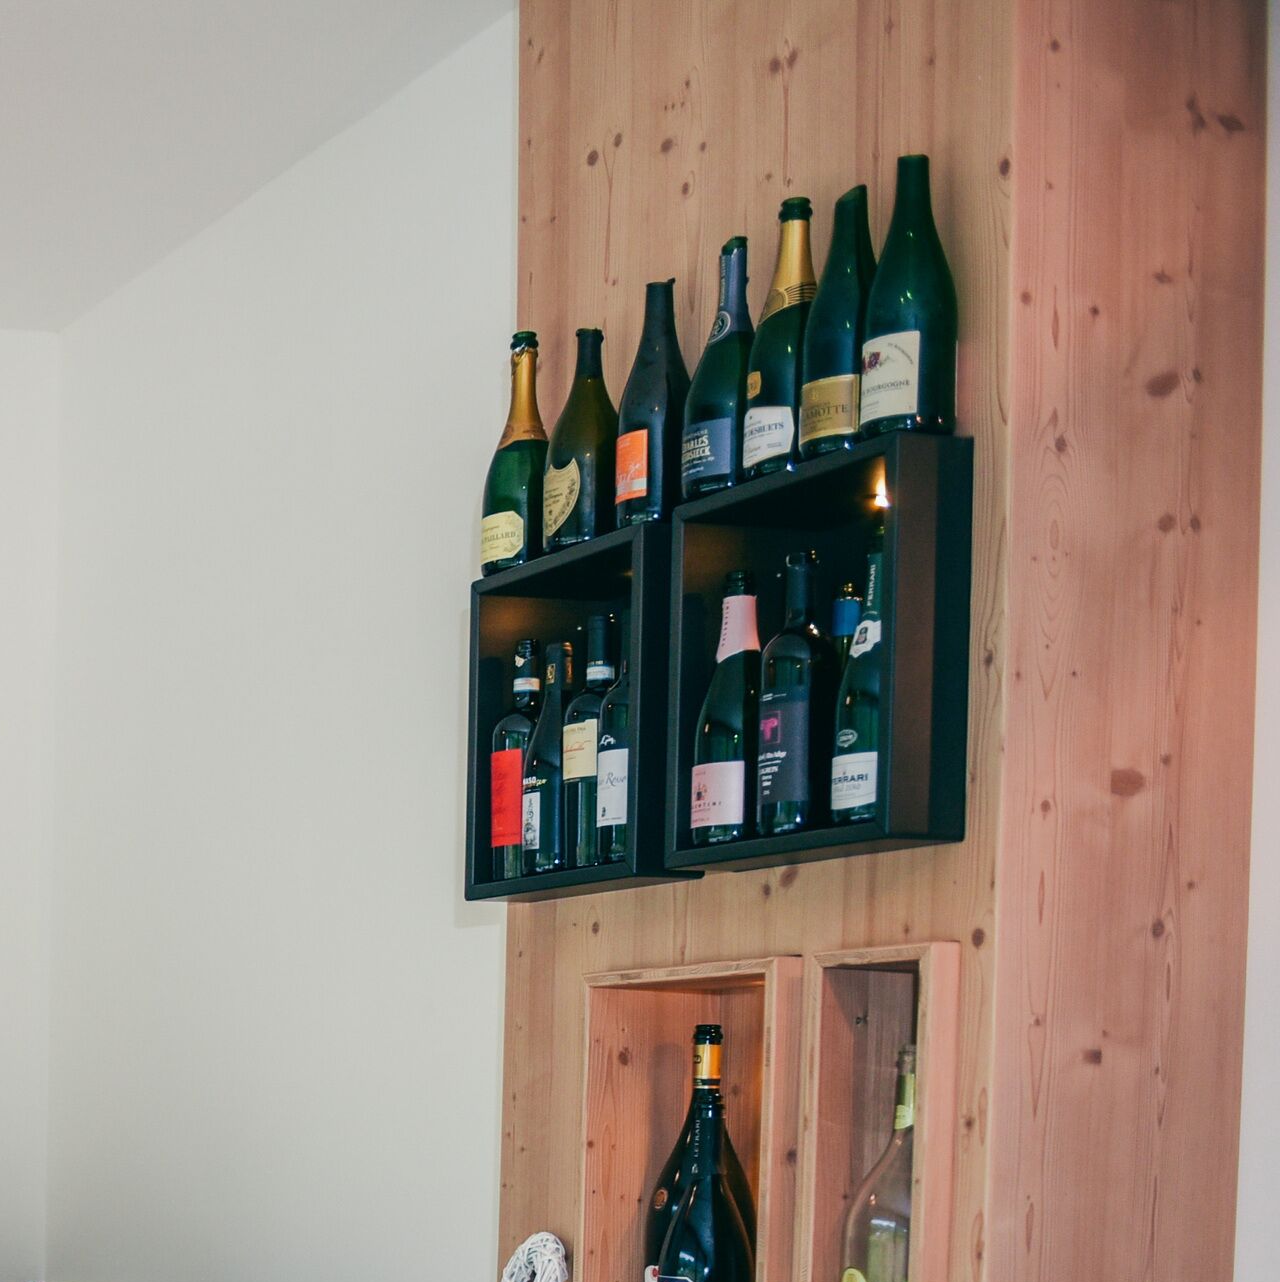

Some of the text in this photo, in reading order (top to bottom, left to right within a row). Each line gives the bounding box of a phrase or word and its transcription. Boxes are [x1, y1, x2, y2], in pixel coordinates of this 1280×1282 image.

[801, 403, 850, 421] AMOTTE
[867, 564, 876, 607] FERRARI
[832, 773, 868, 785] ERRARI
